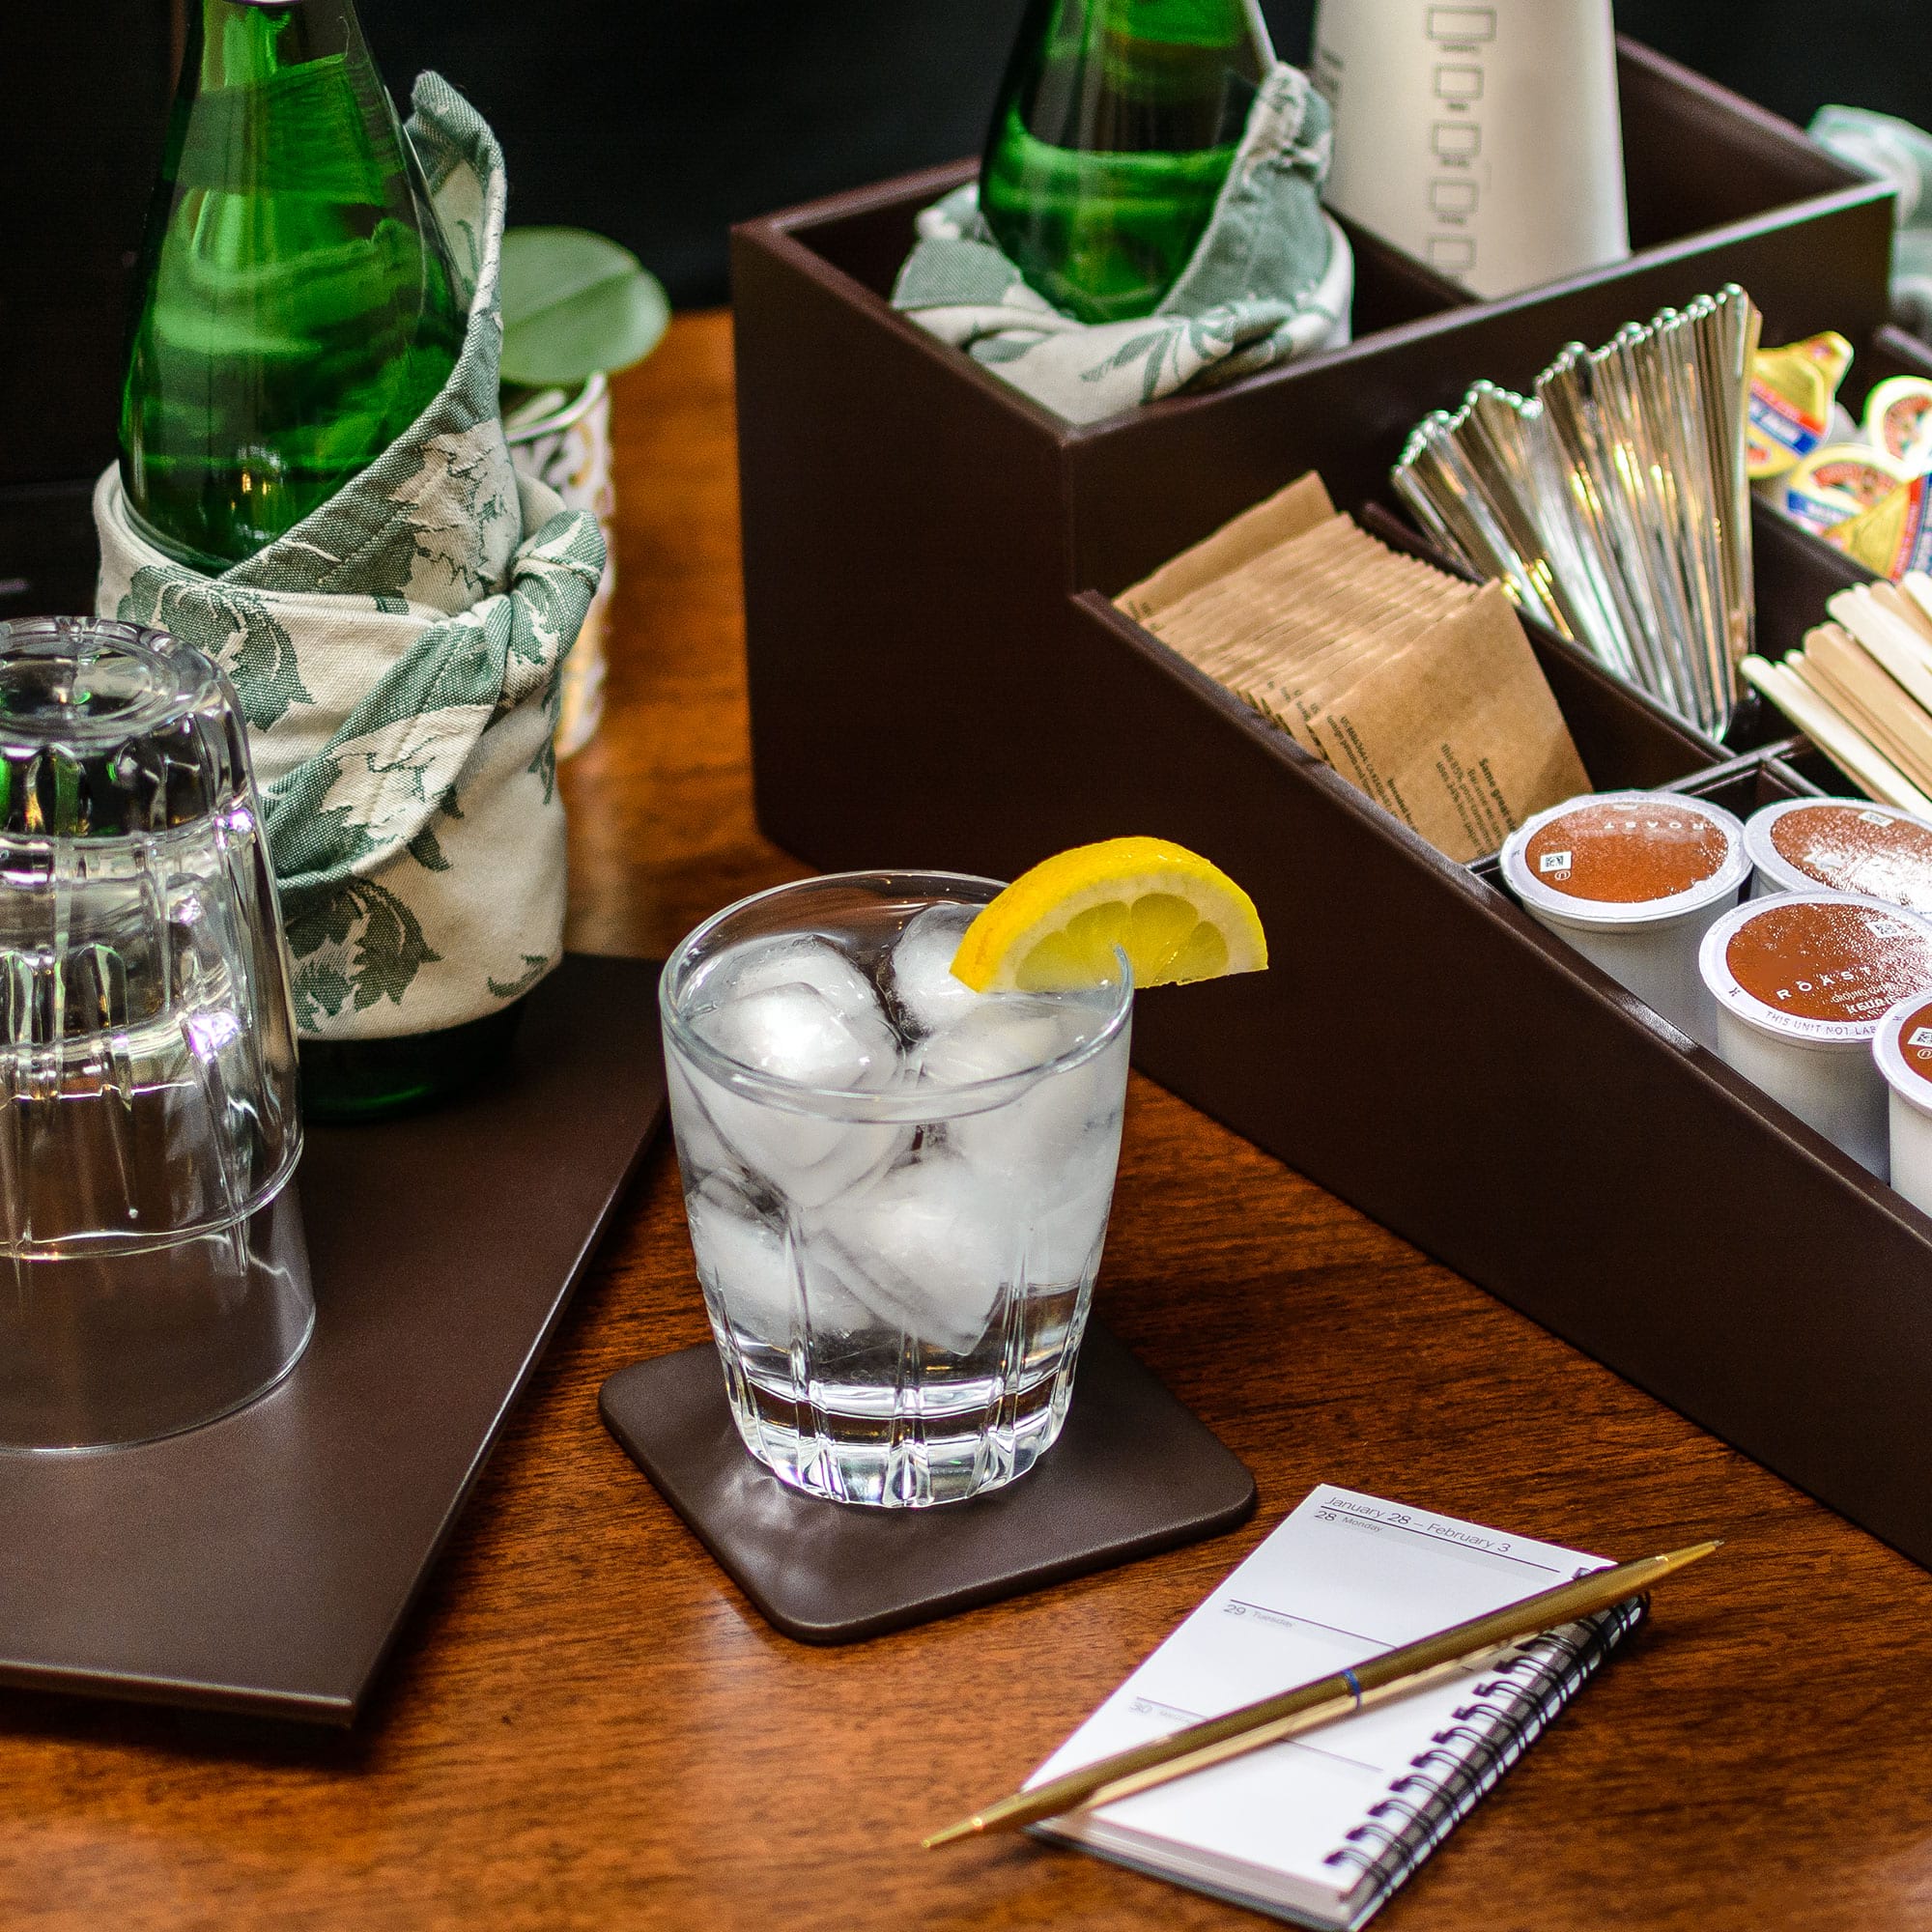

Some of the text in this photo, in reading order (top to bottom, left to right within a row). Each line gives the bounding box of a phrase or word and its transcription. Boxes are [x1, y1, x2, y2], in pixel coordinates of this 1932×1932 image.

[1479, 757, 1494, 787] Same
[1604, 820, 1705, 832] ROAST
[1775, 965, 1872, 1001] ROAST
[1766, 1010, 1790, 1027] THIS
[1793, 1020, 1822, 1033] UNIT
[1825, 1026, 1850, 1036] NOT
[1315, 1510, 1384, 1533] 28 Monday
[1325, 1496, 1384, 1518] January
[1386, 1512, 1412, 1525] 28
[1427, 1522, 1496, 1548] February
[1496, 1542, 1512, 1553] 3
[1223, 1604, 1246, 1616] 29
[1128, 1701, 1153, 1715] 30
